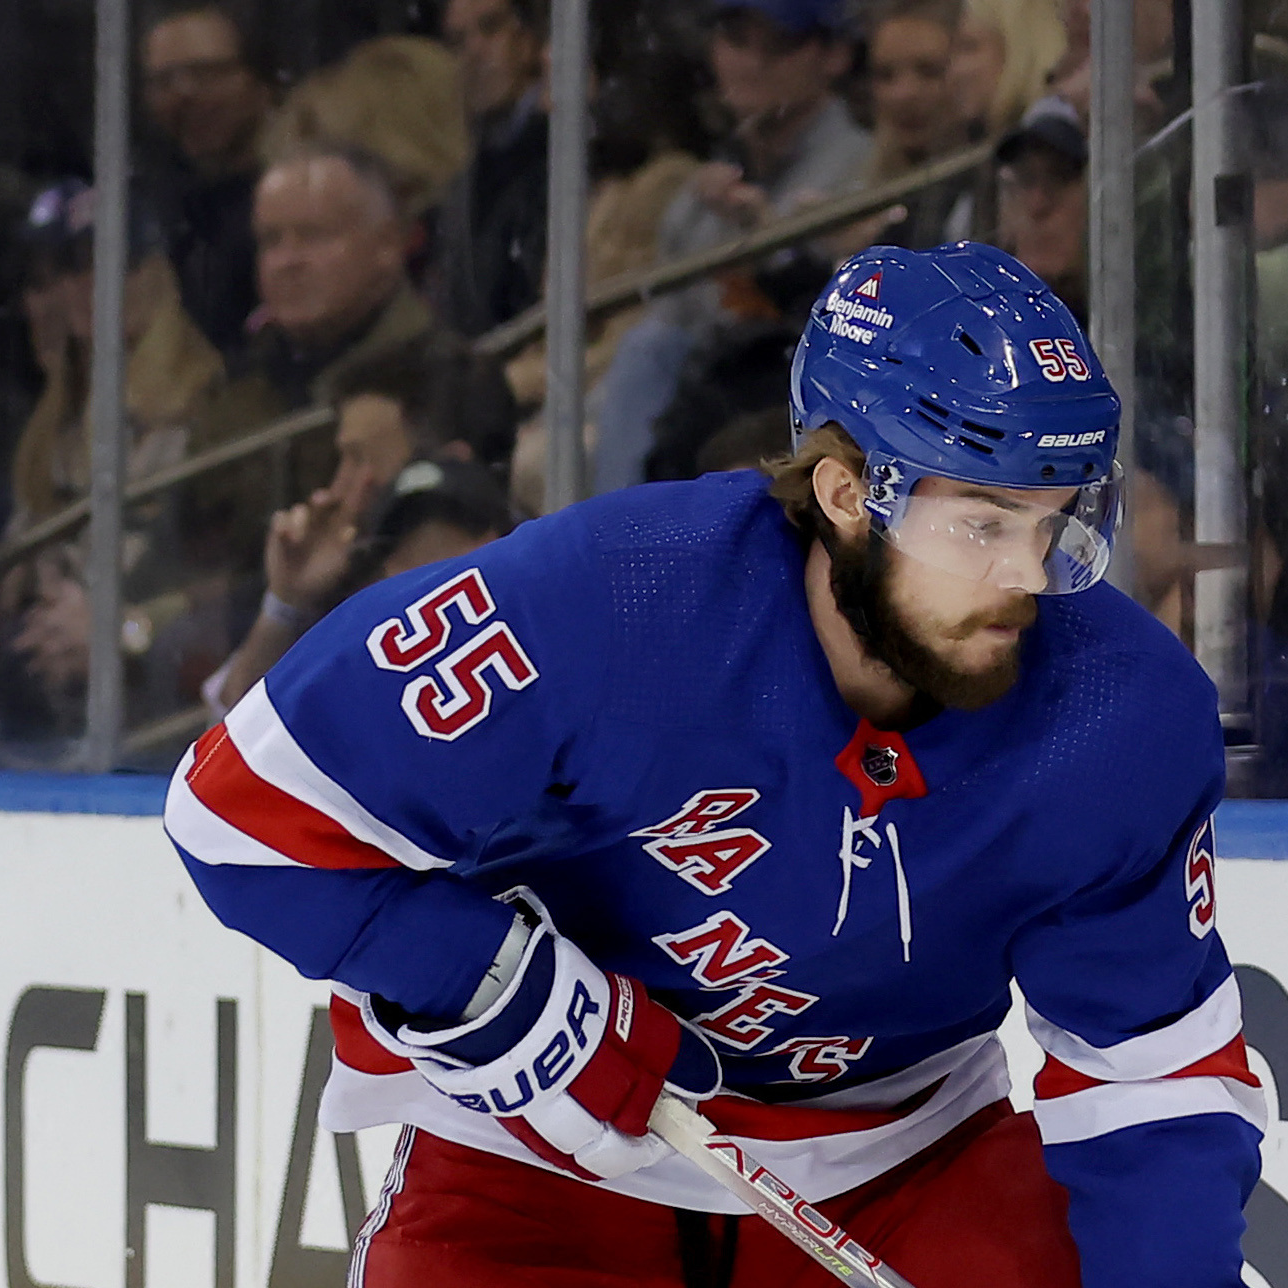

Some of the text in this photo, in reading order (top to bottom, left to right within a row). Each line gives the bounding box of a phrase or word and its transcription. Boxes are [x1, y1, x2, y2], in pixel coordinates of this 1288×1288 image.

[826, 288, 894, 329] Benjamin
[829, 313, 874, 345] Moore
[1029, 338, 1089, 382] 55
[1036, 430, 1106, 448] BAUER
[365, 566, 540, 742] 55
[1184, 818, 1216, 941] 5
[628, 788, 874, 1085] RANES
[451, 978, 600, 1113] AUER
[703, 1131, 882, 1286] APOR
[758, 1201, 854, 1277] HYPERLITE
